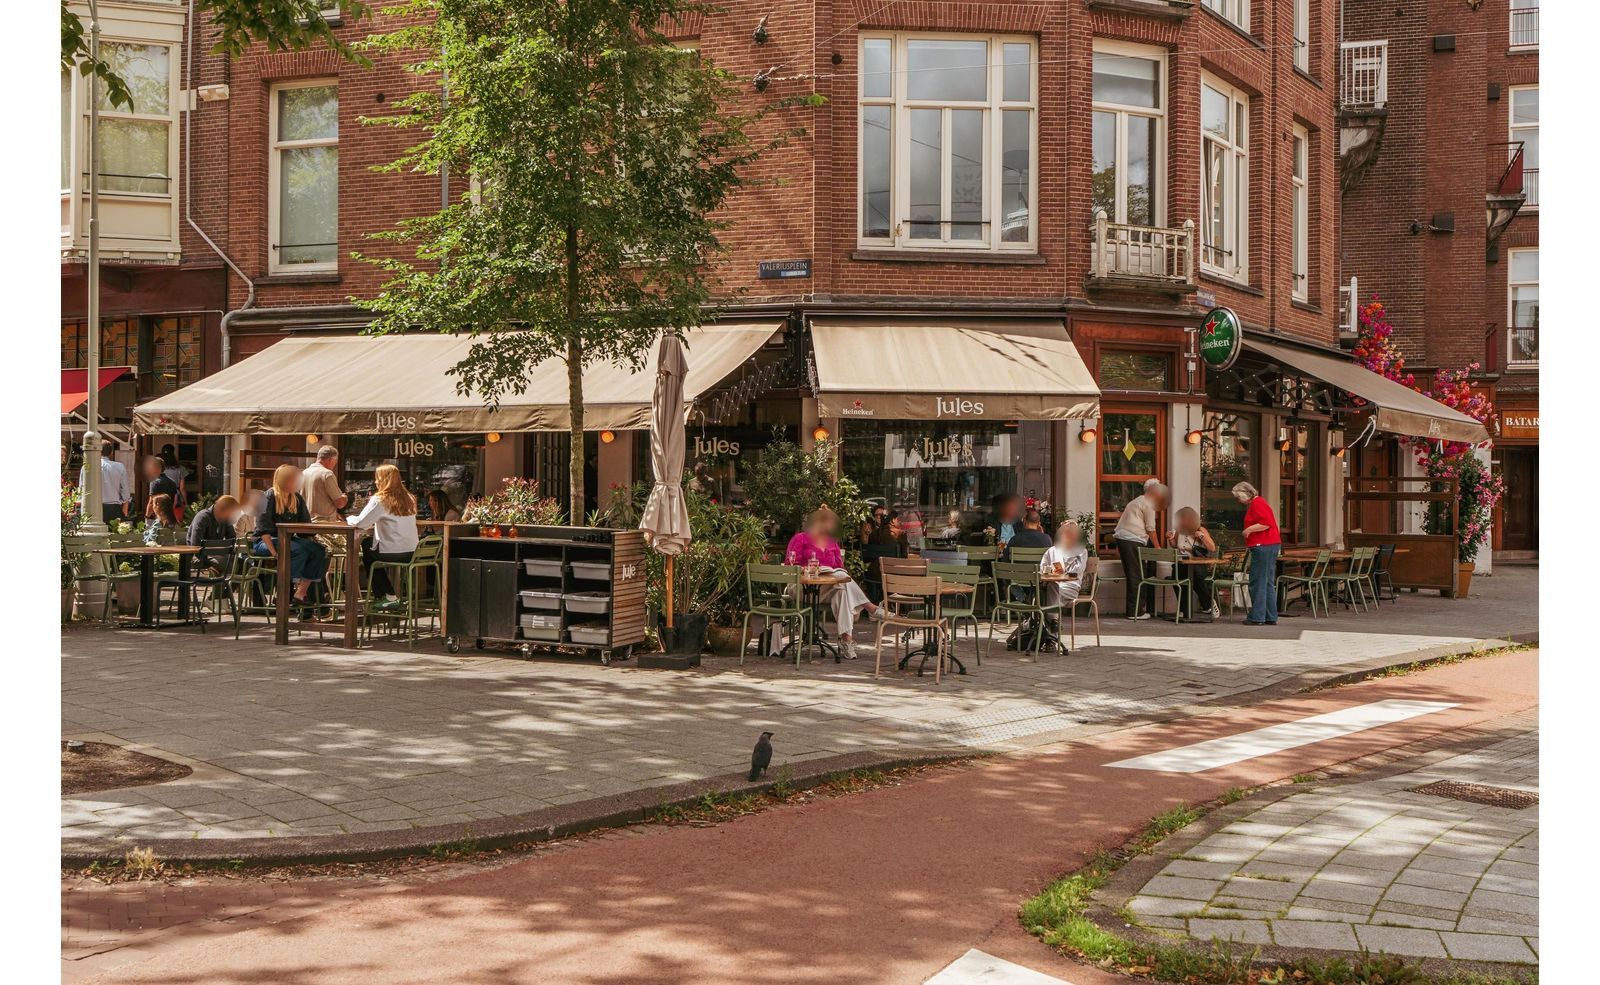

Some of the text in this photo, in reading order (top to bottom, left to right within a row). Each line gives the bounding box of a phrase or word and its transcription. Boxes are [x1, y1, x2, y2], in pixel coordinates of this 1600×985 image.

[761, 262, 807, 271] VALERIUSPLEIN
[936, 396, 984, 418] Jules
[374, 412, 416, 432] Jules
[393, 438, 434, 459] Jules
[694, 436, 740, 458] Jules
[923, 437, 973, 460] Jules
